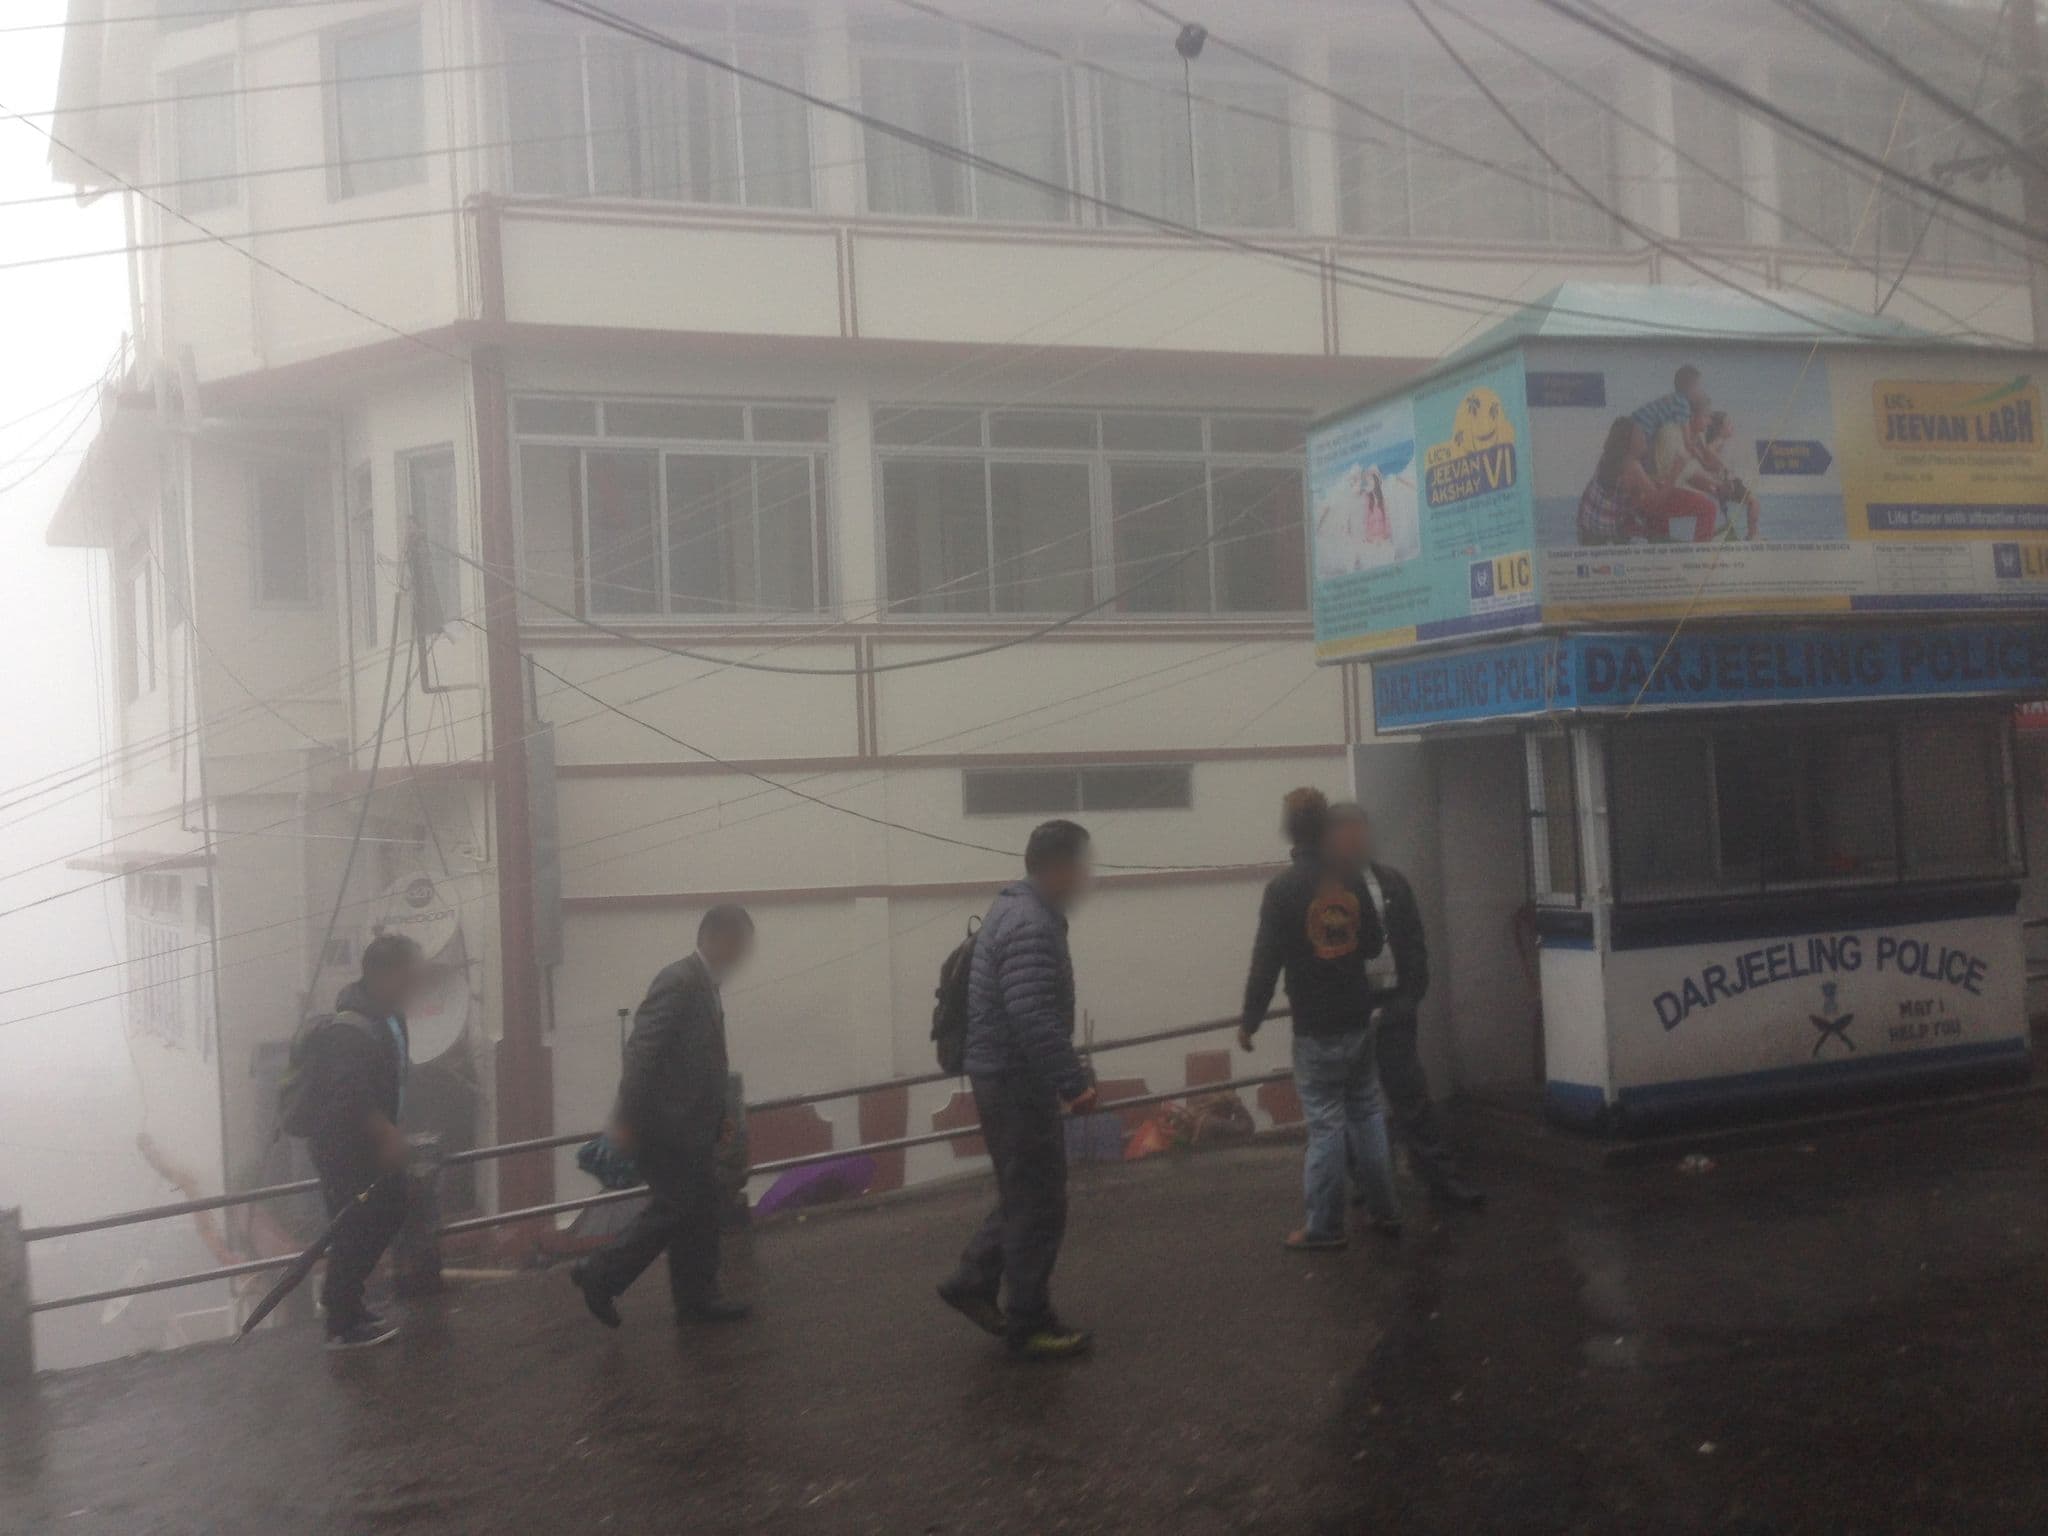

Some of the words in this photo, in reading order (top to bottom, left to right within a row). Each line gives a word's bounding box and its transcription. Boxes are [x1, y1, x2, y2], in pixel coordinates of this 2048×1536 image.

[1886, 414, 1968, 442] JEEVAN
[1976, 400, 2034, 443] LABH
[1432, 453, 1480, 486] JEEVAN
[1483, 447, 1513, 489] VI
[1431, 478, 1481, 504] AKSHAY
[1887, 510, 1908, 525] Life
[1497, 557, 1530, 591] LIC
[2023, 546, 2048, 576] LI
[1586, 641, 1885, 694] DARJEELING
[1379, 662, 1489, 715] DARJEELING
[1653, 935, 1863, 1031] DARJEELING
[1877, 936, 1987, 996] POLICE
[1899, 999, 1934, 1018] MAY
